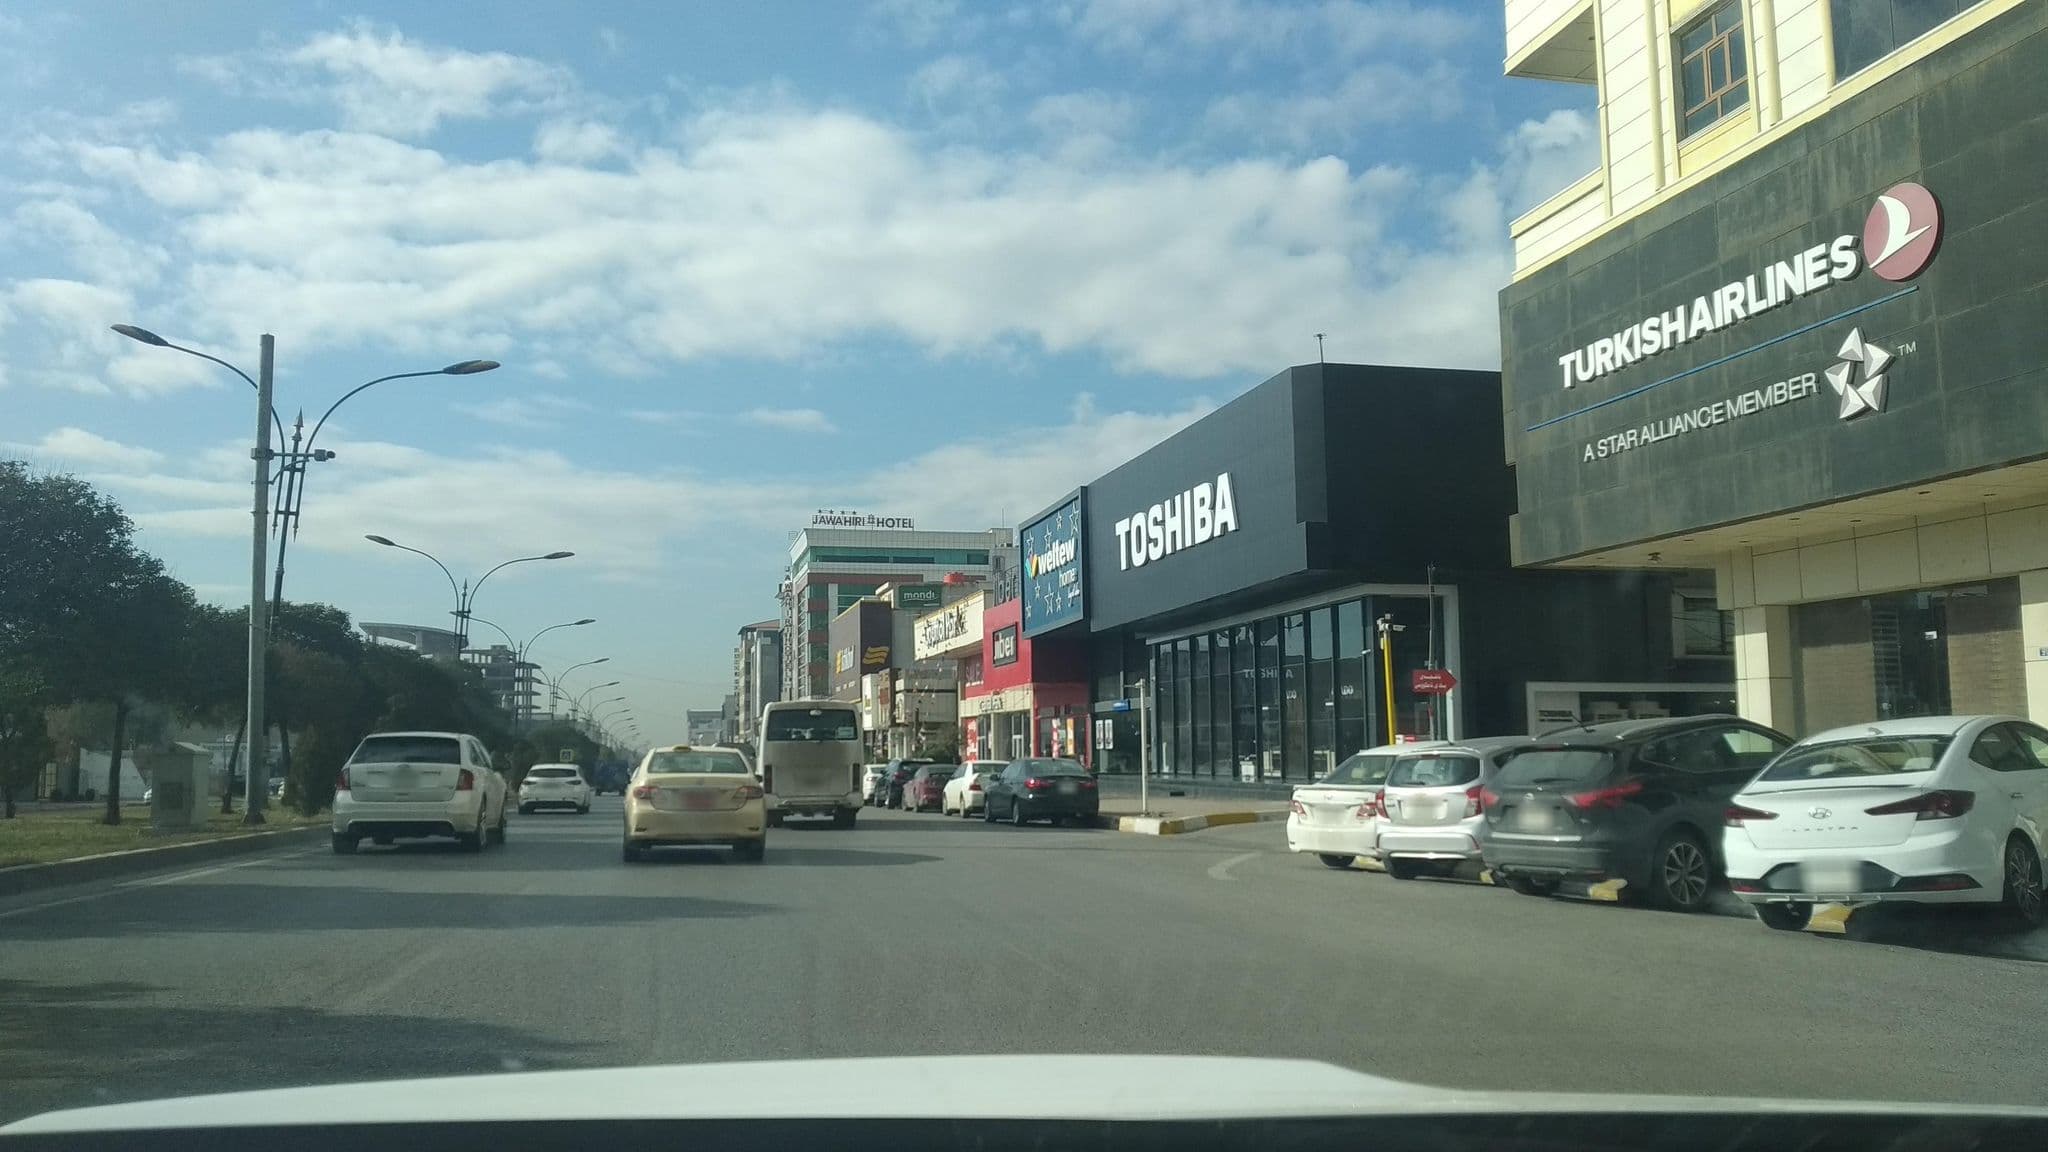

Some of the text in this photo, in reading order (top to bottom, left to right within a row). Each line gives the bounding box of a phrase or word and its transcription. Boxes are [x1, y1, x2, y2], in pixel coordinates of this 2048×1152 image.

[1897, 341, 1917, 357] TM
[1583, 372, 1820, 463] A STAR ALLIANCE MEMBER
[812, 515, 915, 529] JAWAHIRI HOTEL
[1115, 472, 1239, 571] TOSHIBA
[1038, 537, 1076, 576] weltew
[1059, 567, 1078, 588] home
[903, 590, 935, 600] mondi
[1244, 669, 1294, 679] TOSHIA
